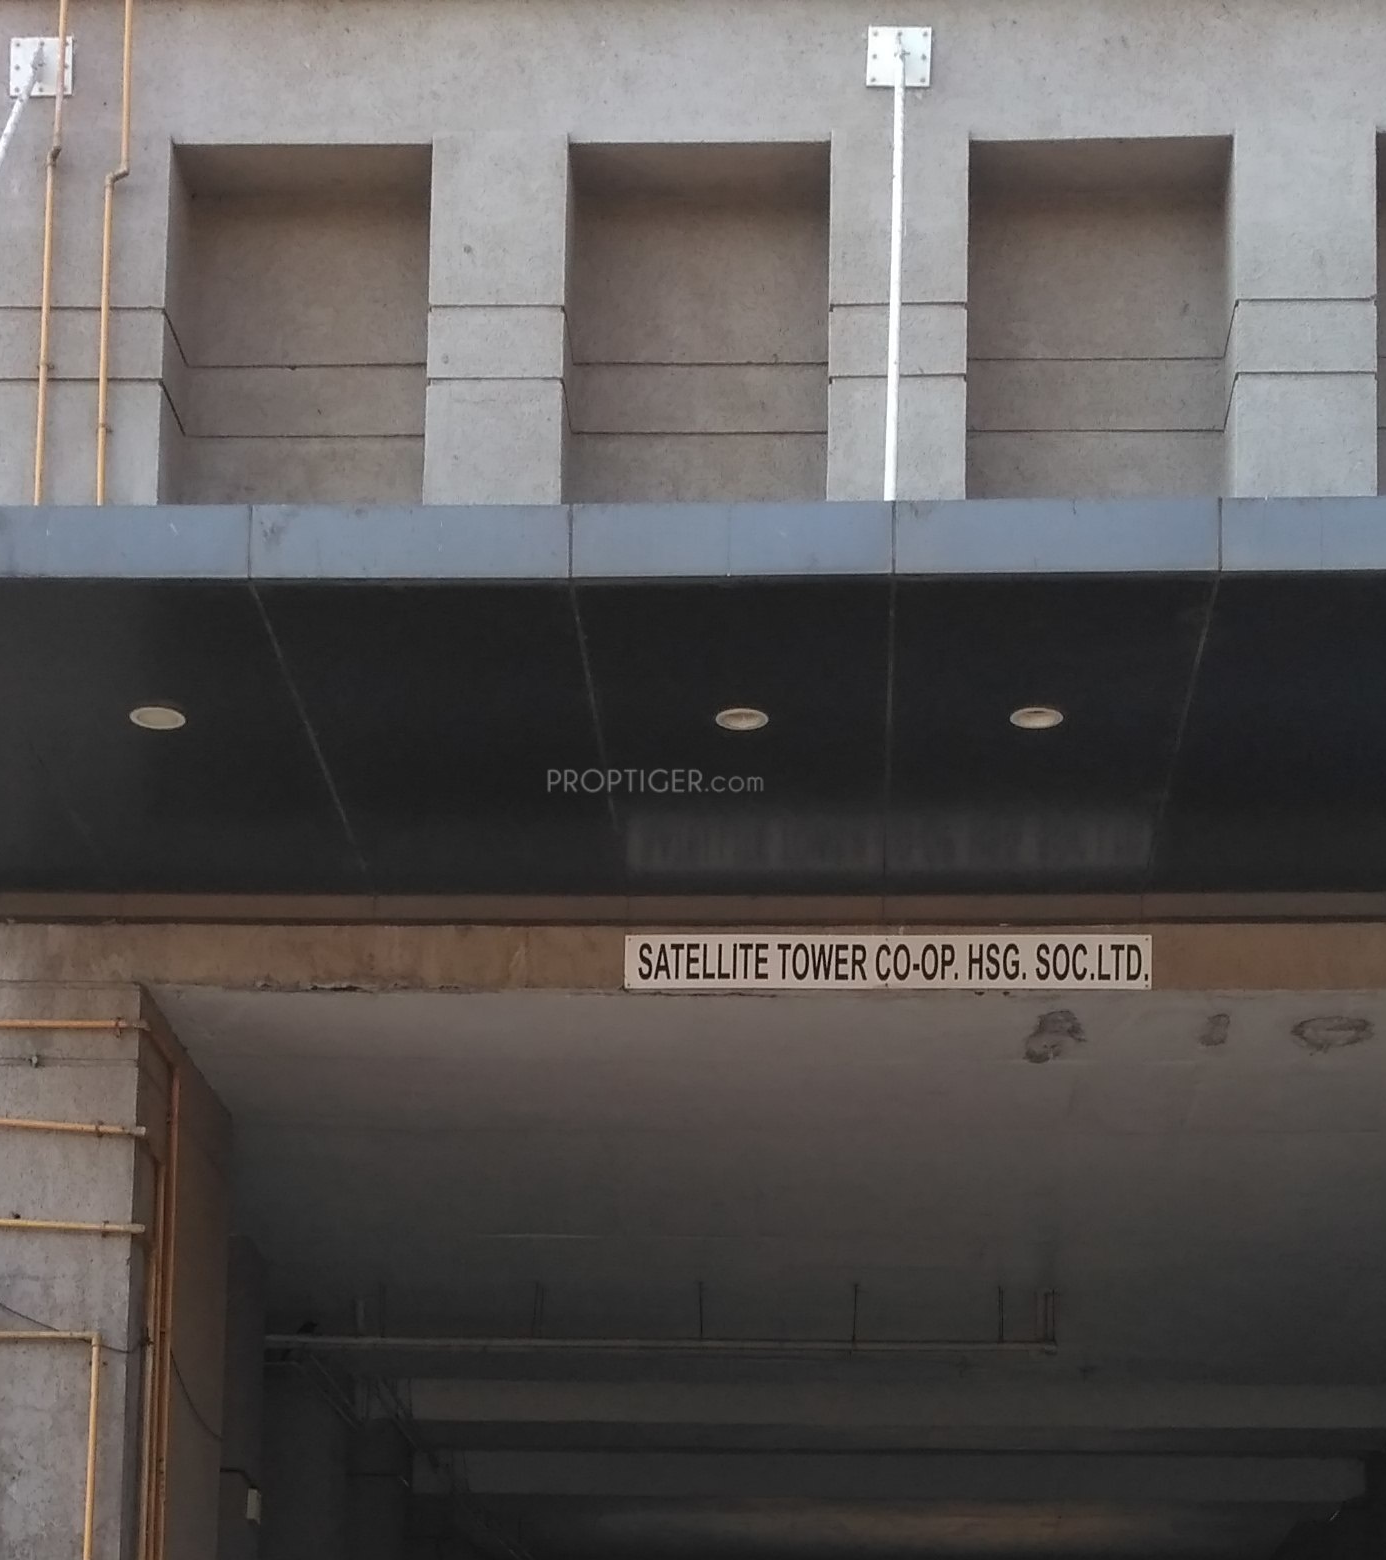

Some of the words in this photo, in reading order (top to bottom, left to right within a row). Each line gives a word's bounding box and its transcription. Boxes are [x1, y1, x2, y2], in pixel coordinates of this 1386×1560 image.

[638, 942, 769, 981] SATELLITE
[777, 942, 868, 981] TOWER
[875, 942, 959, 981] CO-OP.
[968, 942, 1027, 981] HSG.
